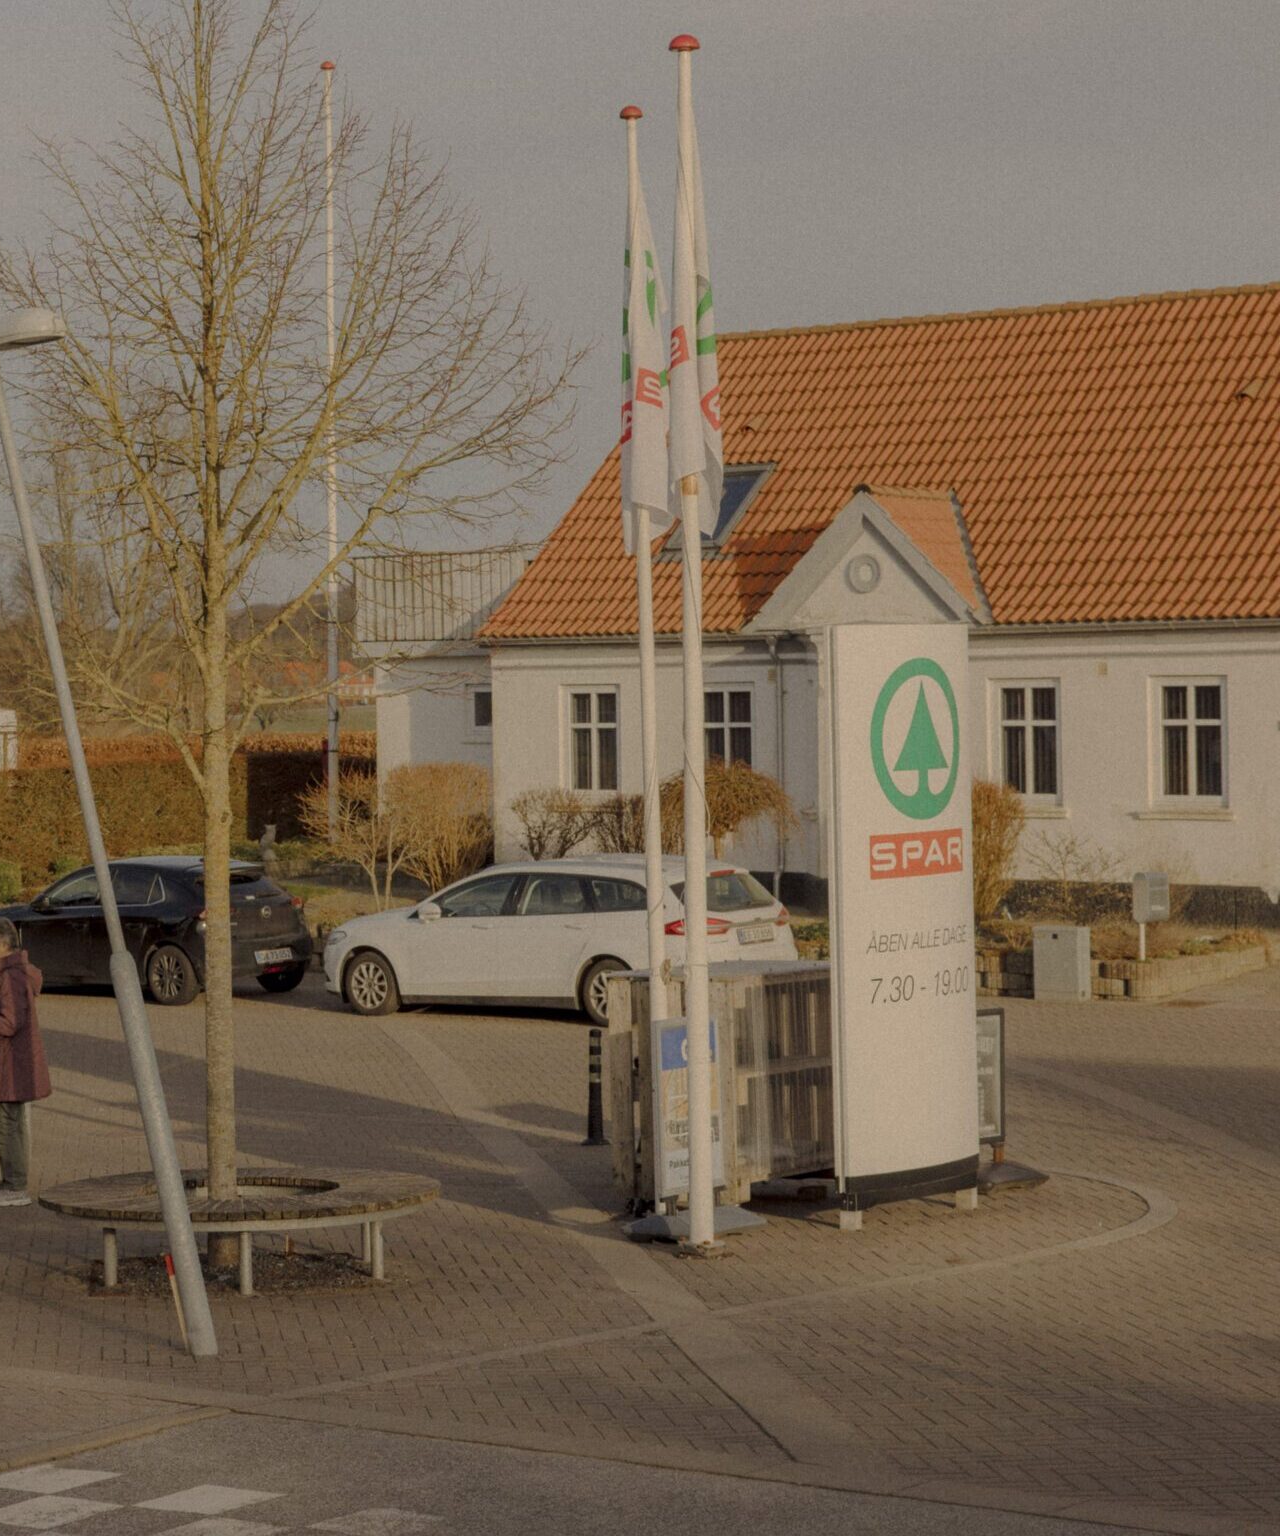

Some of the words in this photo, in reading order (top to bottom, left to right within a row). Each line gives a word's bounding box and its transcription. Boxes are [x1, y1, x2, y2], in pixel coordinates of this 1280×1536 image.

[871, 836, 962, 872] SPAR
[866, 930, 908, 954] ÅBEN
[911, 929, 940, 949] ALLE
[943, 924, 967, 946] DAGE
[871, 974, 914, 1004] 7.30
[934, 966, 969, 997] 19.00
